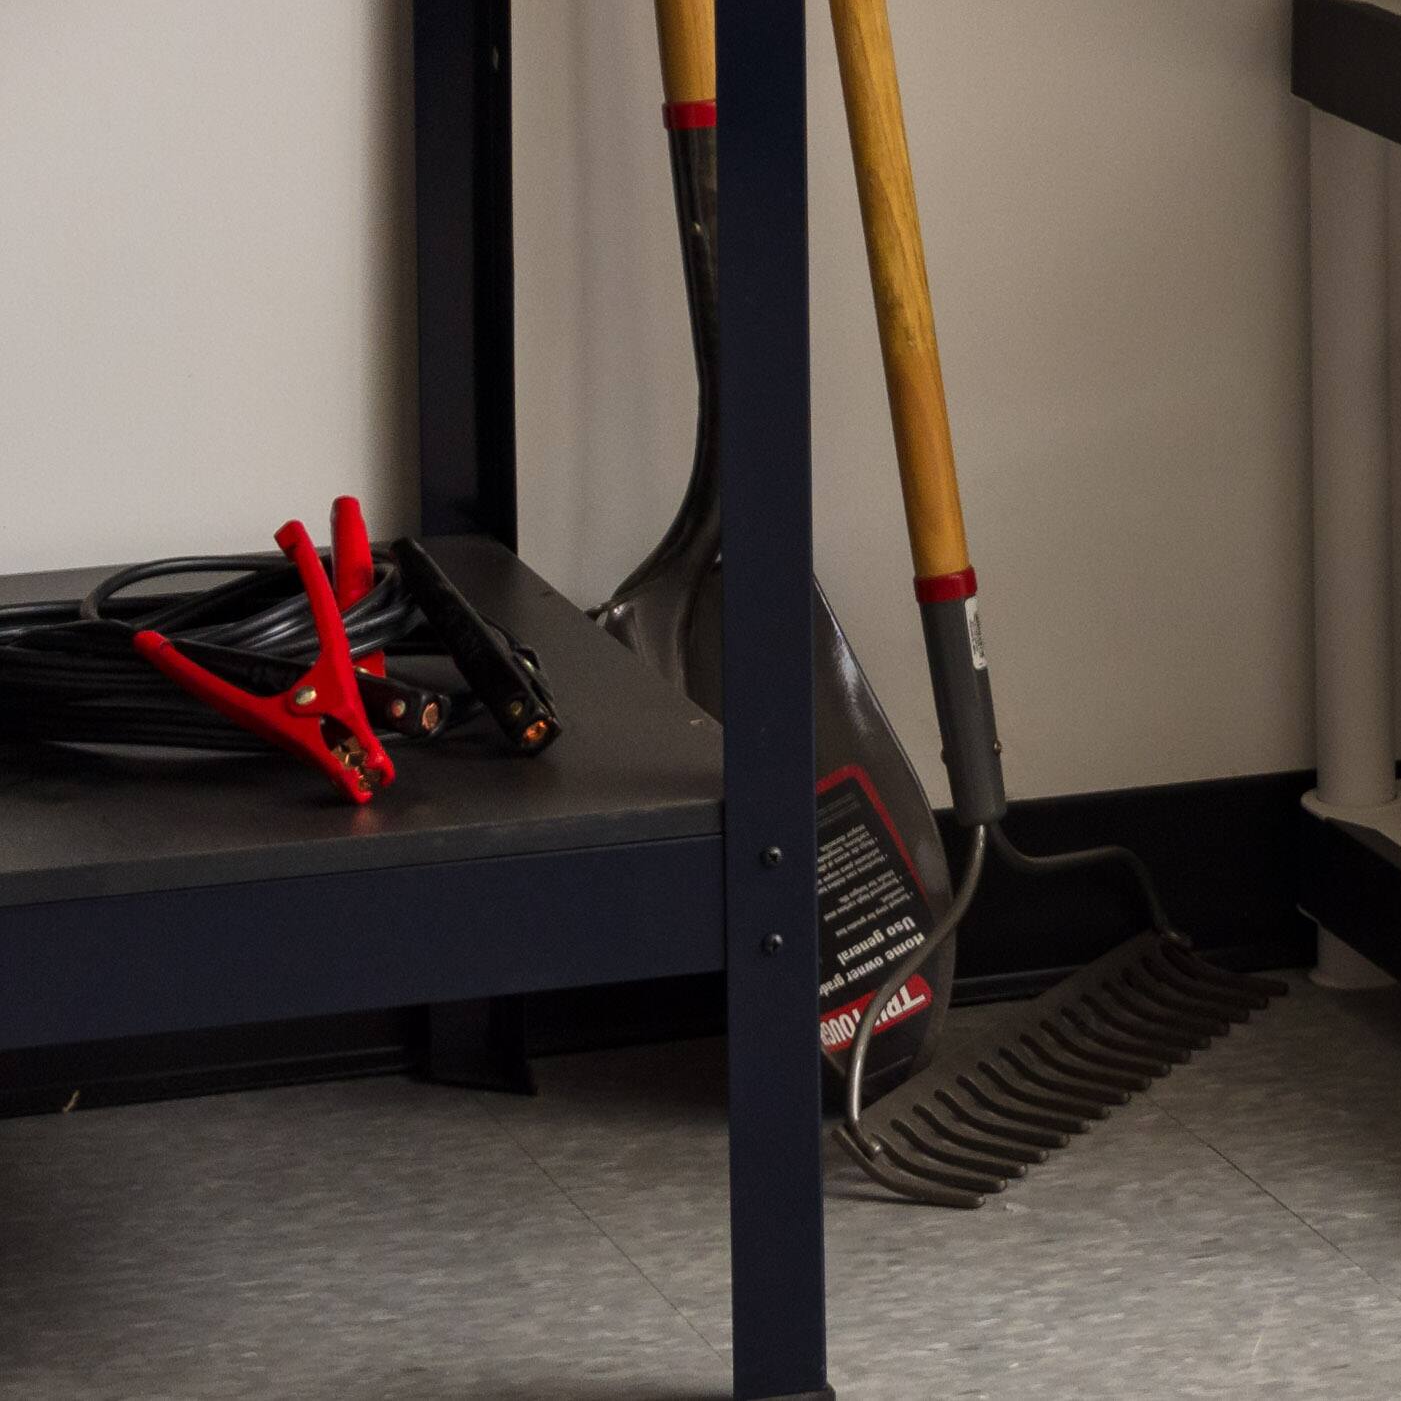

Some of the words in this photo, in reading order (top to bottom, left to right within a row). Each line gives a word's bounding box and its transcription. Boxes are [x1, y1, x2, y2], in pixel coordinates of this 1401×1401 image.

[886, 916, 915, 937] Uso
[837, 929, 885, 966] general
[885, 932, 925, 962] Home
[846, 956, 884, 982] owner
